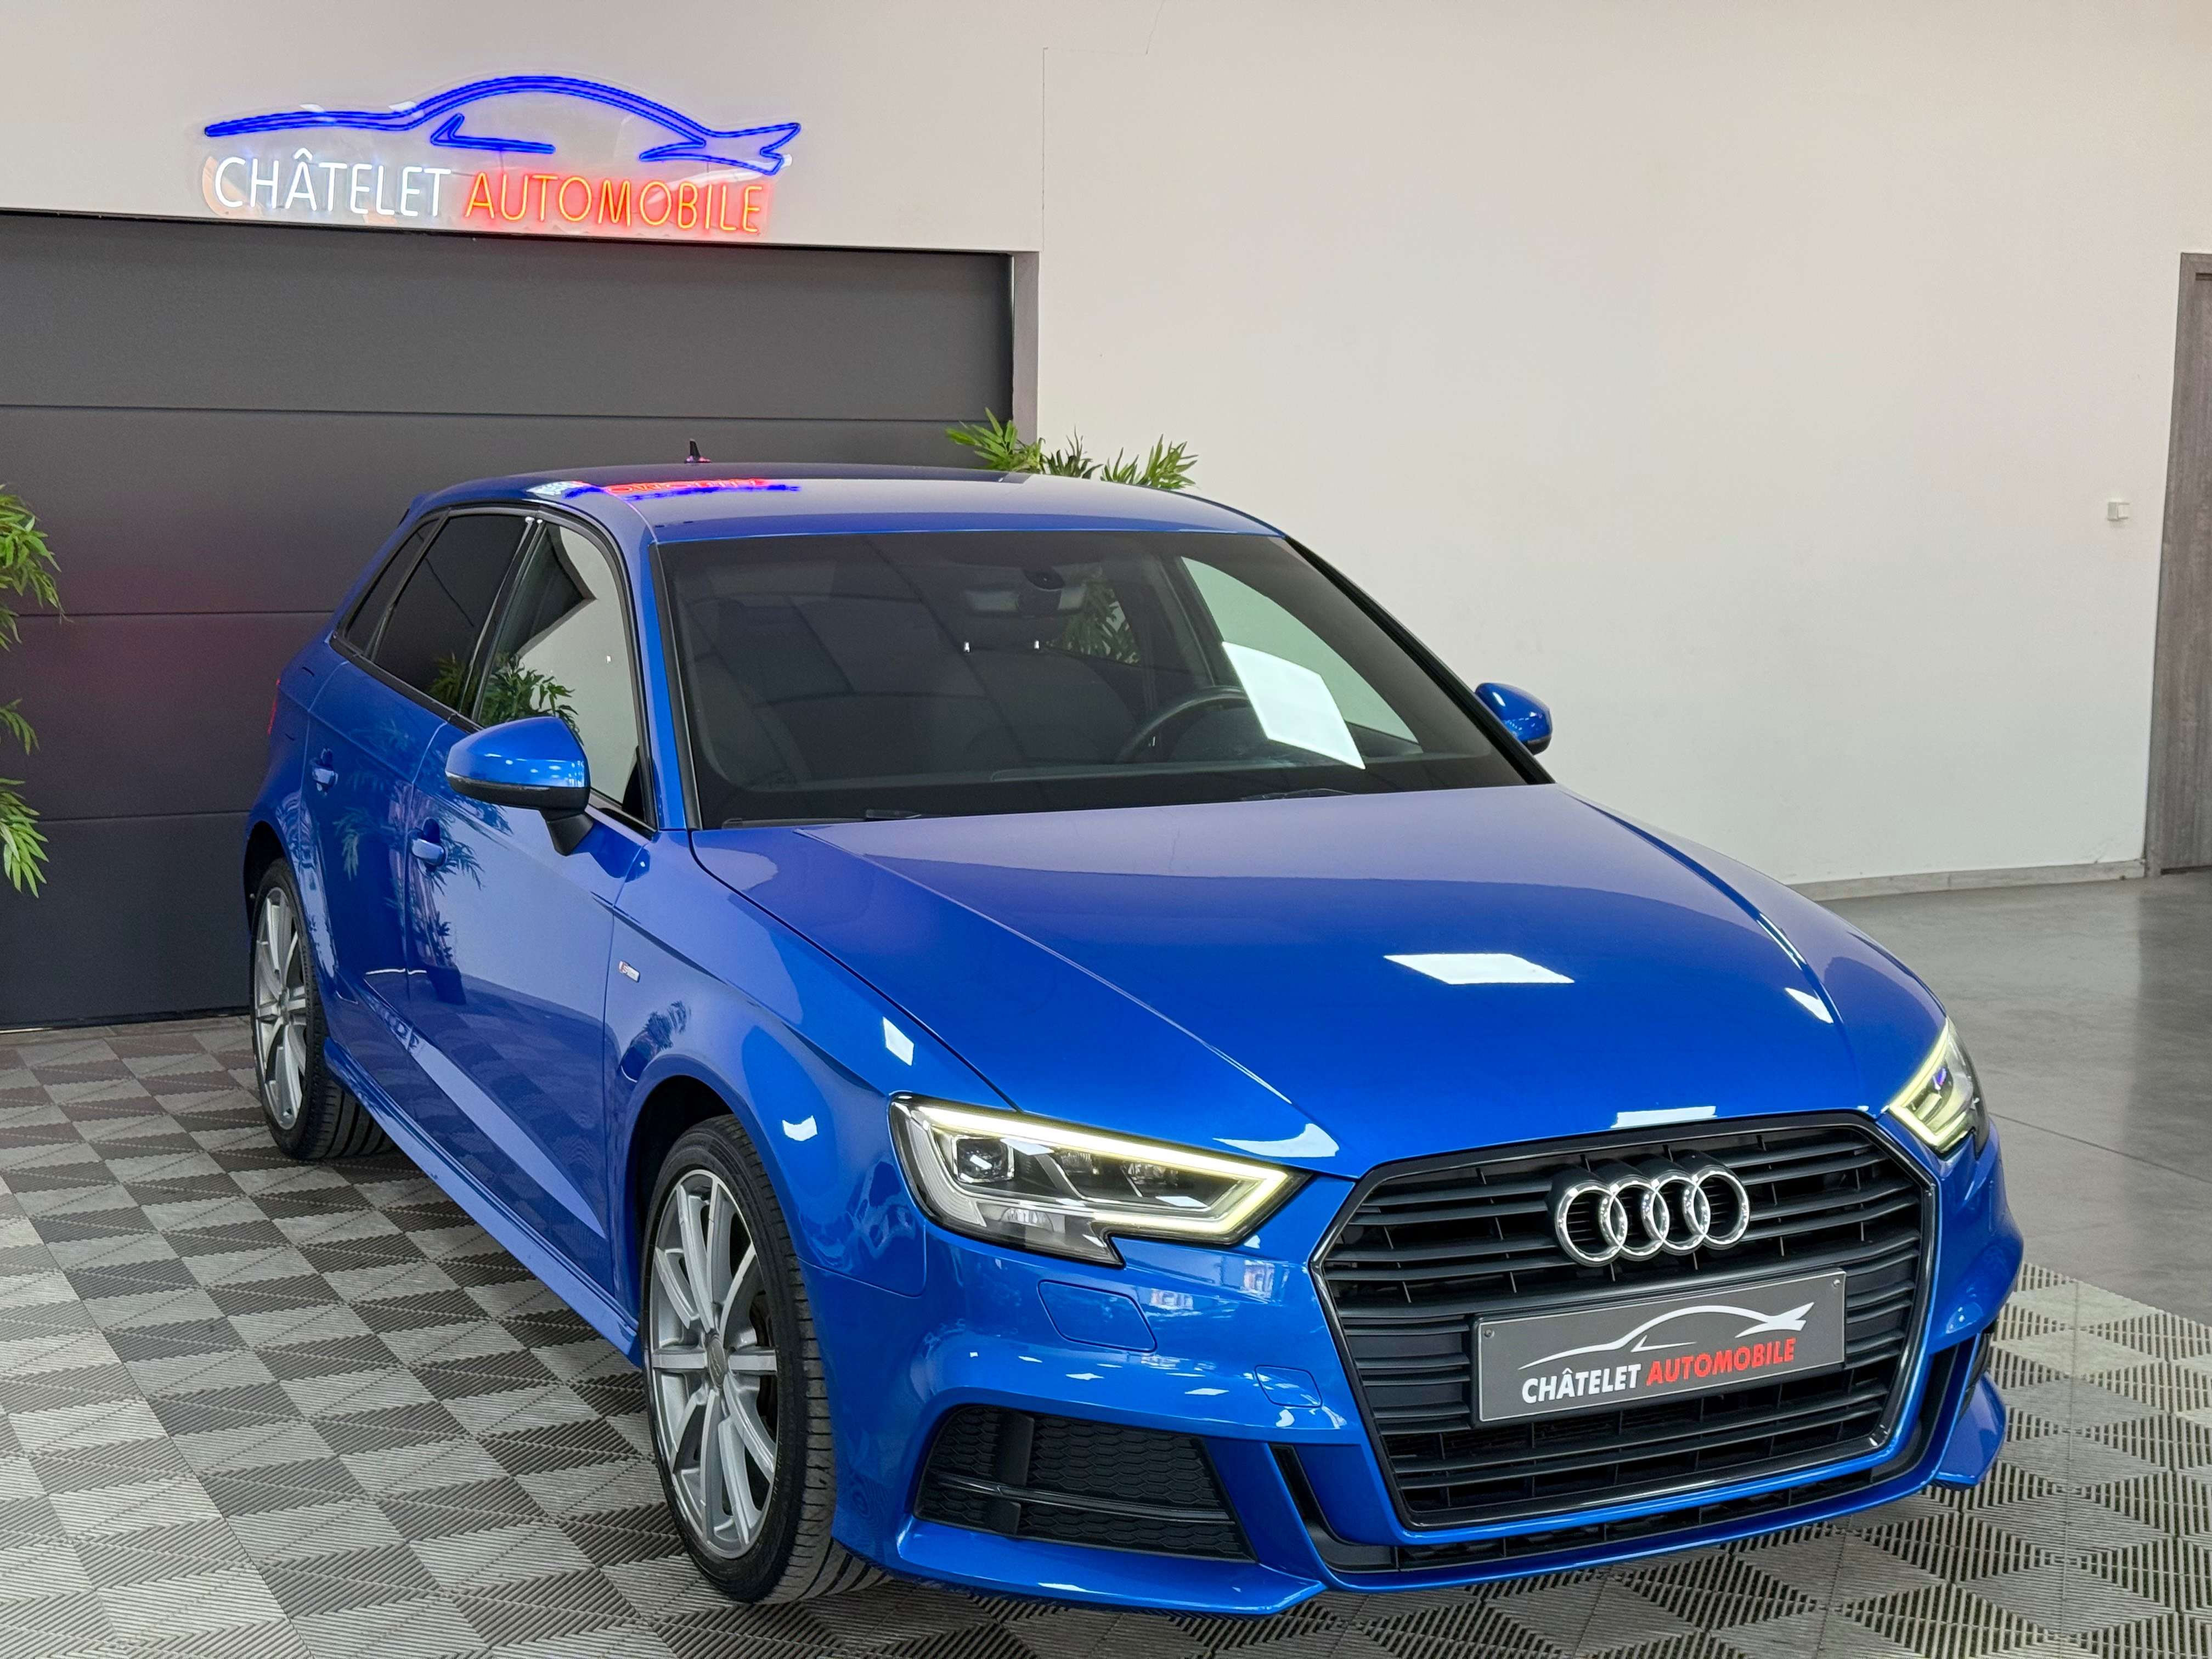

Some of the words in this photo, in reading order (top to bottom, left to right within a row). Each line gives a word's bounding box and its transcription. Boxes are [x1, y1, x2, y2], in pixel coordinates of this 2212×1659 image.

[215, 147, 452, 217] CHÂTELET
[464, 172, 764, 234] AUTOMOBILE
[1521, 1364, 1642, 1404] CHÂTELET
[1646, 1338, 1796, 1386] AUTOMOBILE
